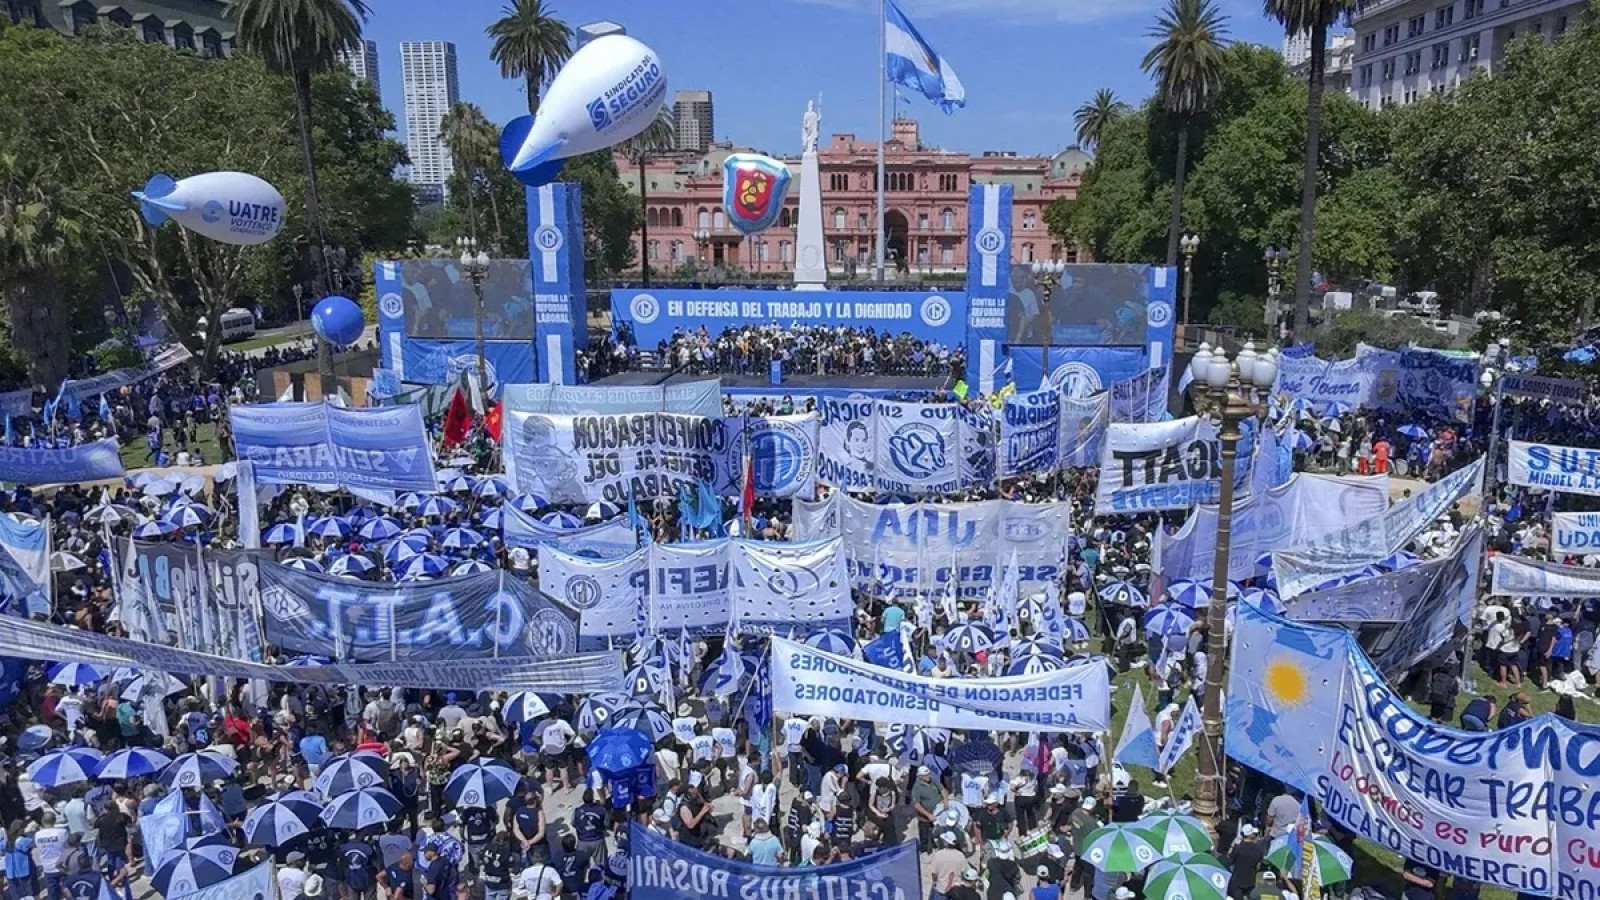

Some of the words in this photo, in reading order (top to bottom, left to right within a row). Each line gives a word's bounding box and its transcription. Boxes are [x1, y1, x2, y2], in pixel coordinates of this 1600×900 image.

[604, 63, 645, 99] SINDICATO
[609, 63, 660, 114] SEGURO
[229, 200, 277, 222] UATRE
[668, 300, 683, 317] EN
[687, 301, 738, 318] DEFENSA
[742, 302, 764, 318] DEL
[768, 302, 821, 319] TRABAJO
[825, 303, 833, 319] Y
[836, 303, 852, 319] LA
[855, 303, 912, 320] DIGNIDAD
[971, 298, 996, 306] CONTRA
[536, 313, 570, 323] LABORAL
[971, 307, 1005, 316] REFORMA
[971, 317, 1005, 328] LABORAL
[1552, 383, 1581, 398] TODOS
[1527, 471, 1572, 488] MIGUEL
[948, 632, 988, 648] UDA
[1373, 737, 1466, 809] CREAR
[1435, 821, 1469, 845] es
